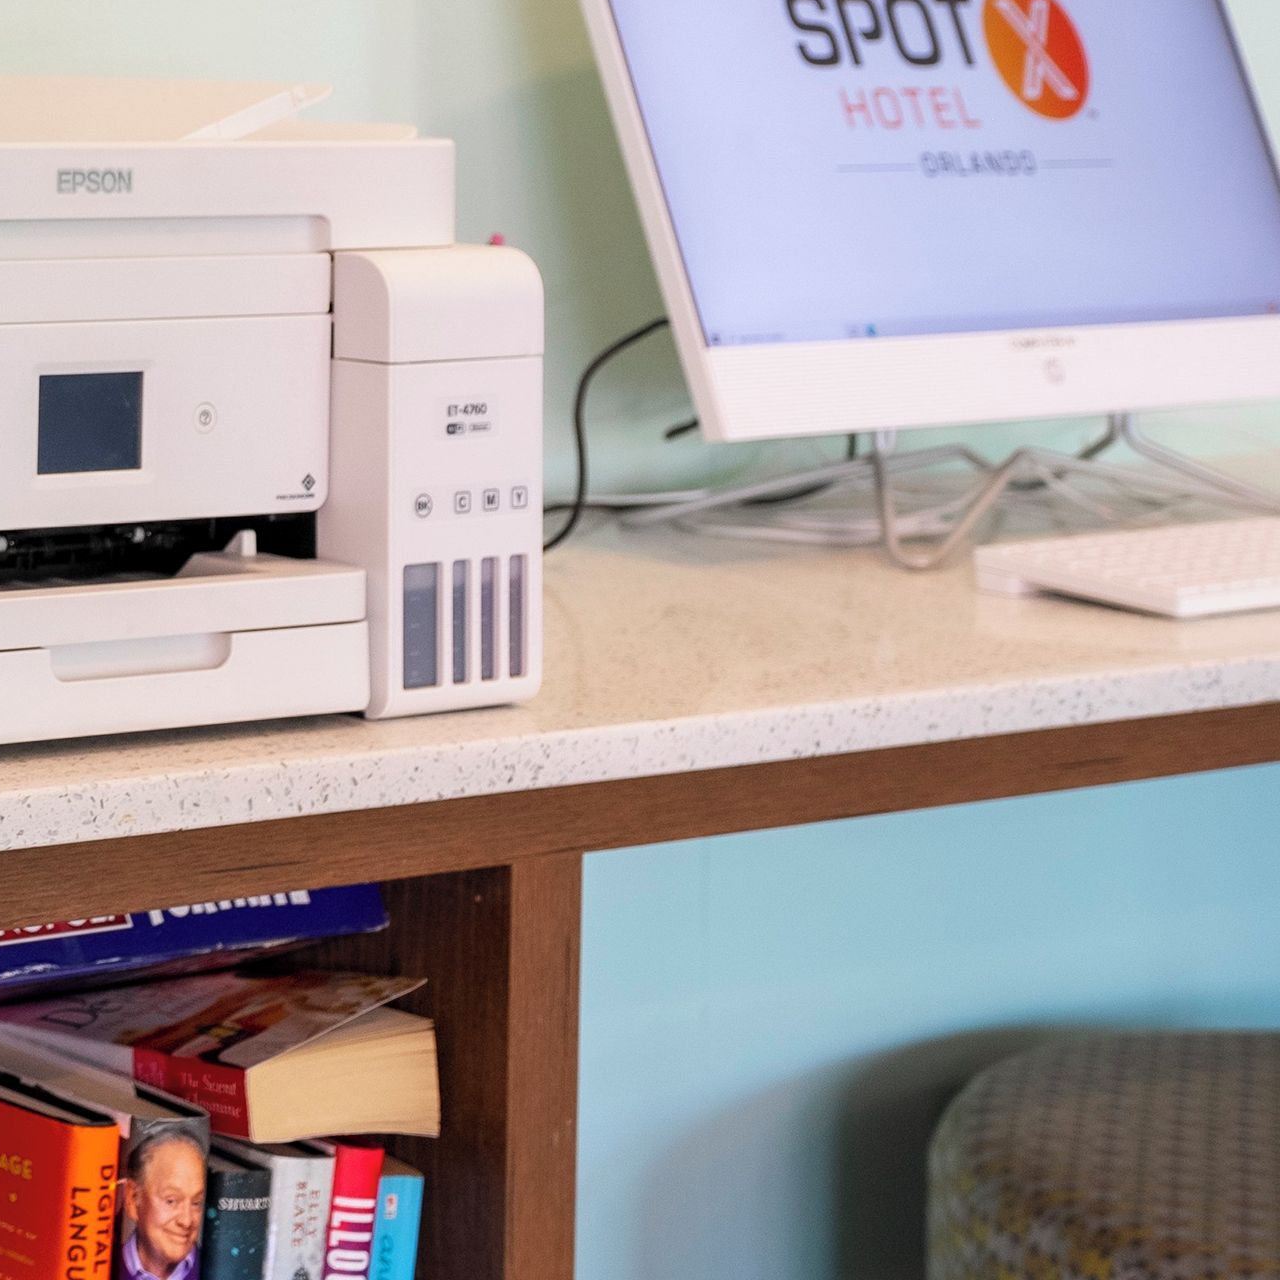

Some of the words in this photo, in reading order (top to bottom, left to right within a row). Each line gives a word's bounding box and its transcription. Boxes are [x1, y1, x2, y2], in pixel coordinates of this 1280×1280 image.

[841, 86, 982, 130] HOTEL
[919, 149, 1037, 178] ORLANDO
[57, 168, 133, 194] EPSON
